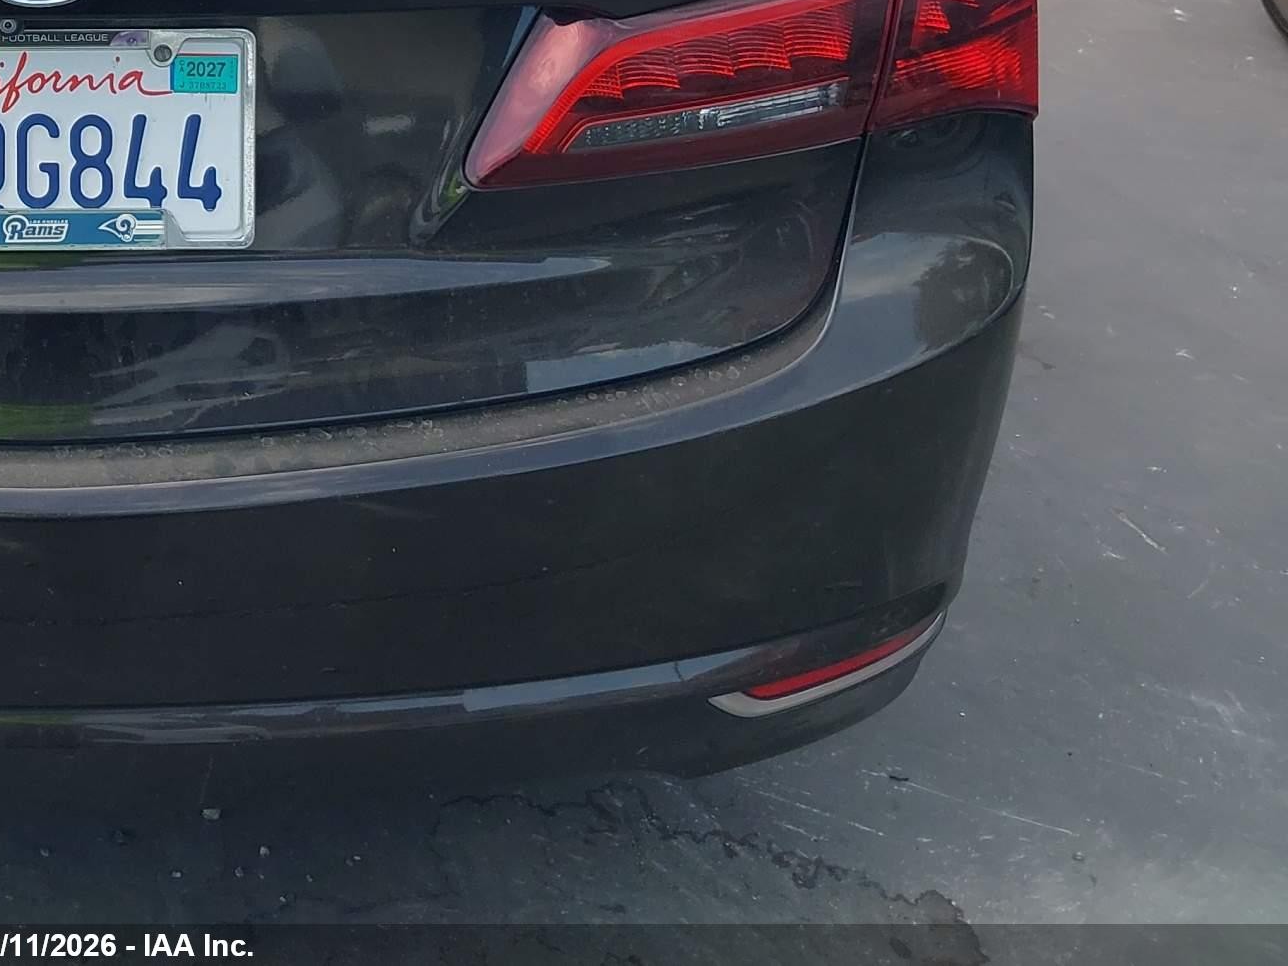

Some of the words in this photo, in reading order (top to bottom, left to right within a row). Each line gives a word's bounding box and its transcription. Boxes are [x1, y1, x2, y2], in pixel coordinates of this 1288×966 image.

[1, 34, 60, 43] FOOTBALL
[64, 33, 109, 42] LEAGUE
[186, 61, 226, 77] 2027
[3, 215, 68, 242] Rams
